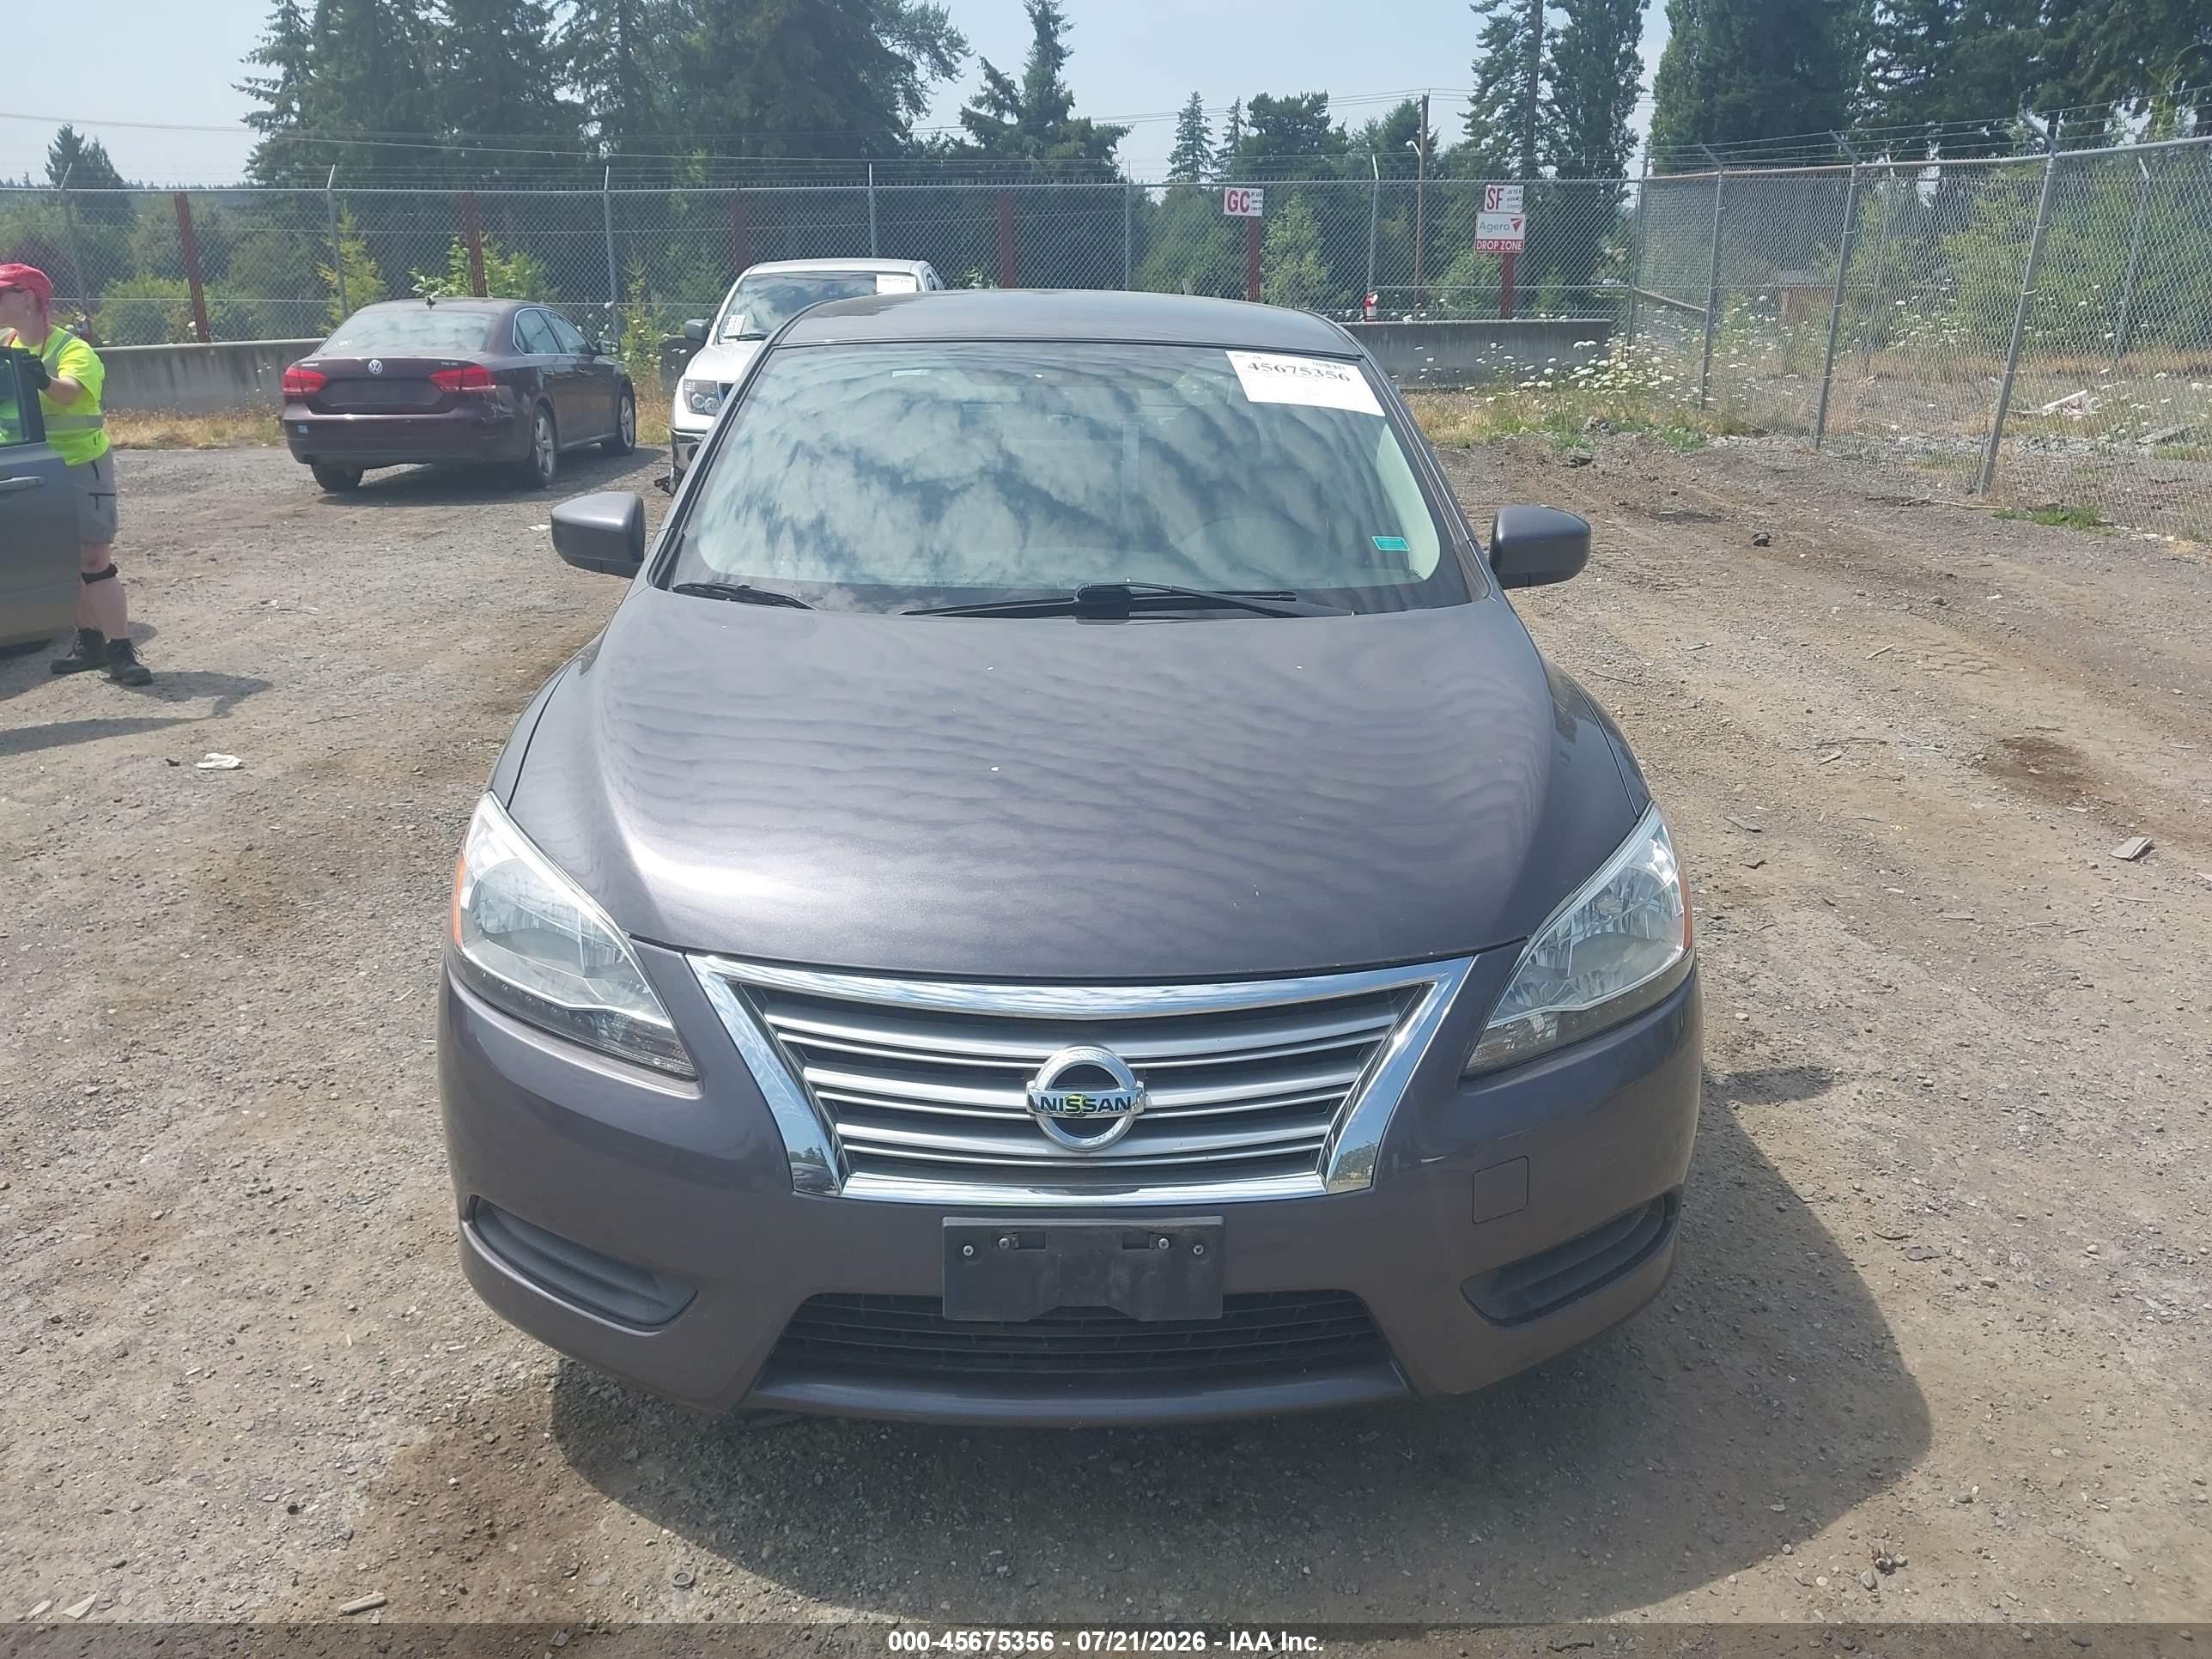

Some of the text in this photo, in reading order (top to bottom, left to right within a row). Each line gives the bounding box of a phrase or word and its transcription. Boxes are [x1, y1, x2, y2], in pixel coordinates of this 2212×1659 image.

[1228, 190, 1250, 213] GC
[1486, 187, 1504, 210] SF
[1479, 222, 1510, 233] Agero
[1477, 240, 1522, 250] DROP ZONE
[1248, 362, 1351, 382] 45675356
[1040, 1096, 1131, 1113] NISSAN
